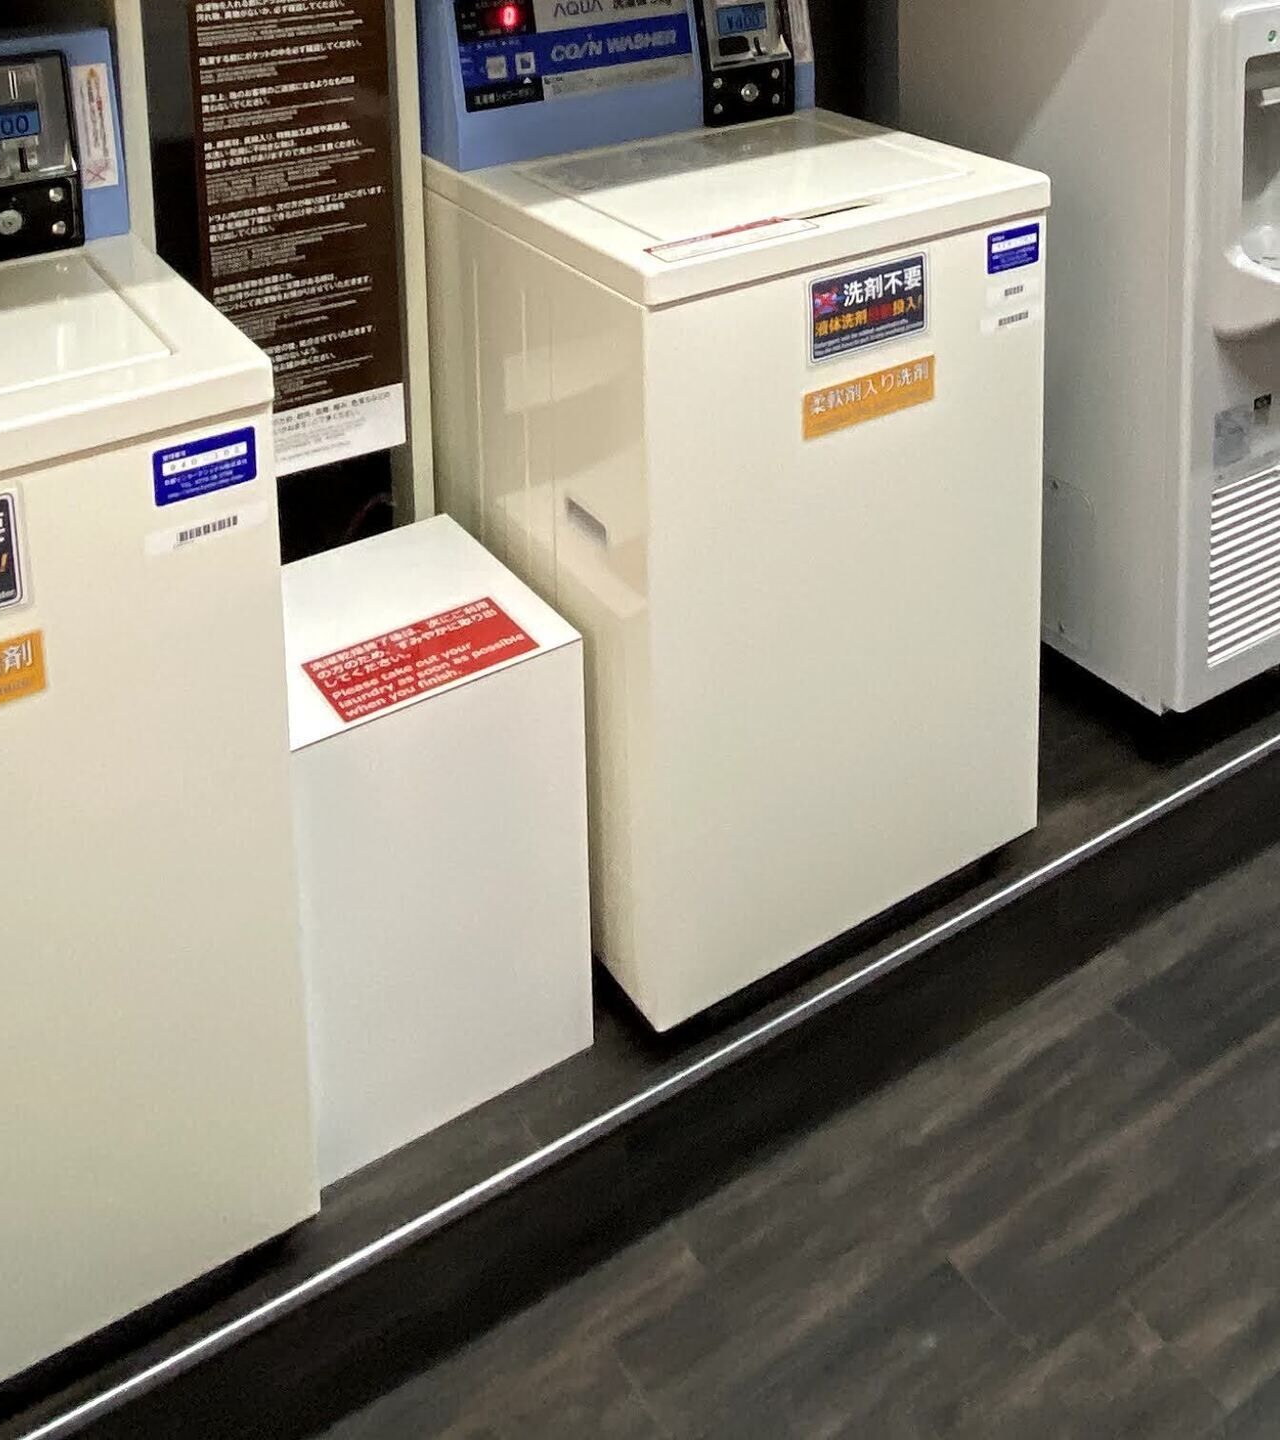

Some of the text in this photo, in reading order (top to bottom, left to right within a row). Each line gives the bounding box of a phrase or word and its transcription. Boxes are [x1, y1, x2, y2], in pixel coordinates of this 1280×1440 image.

[504, 5, 516, 27] 0
[550, 28, 678, 62] COIN WASHER
[843, 264, 922, 307] 洗剤不要
[810, 362, 929, 416] 柔軟剤入り洗剤
[331, 642, 472, 701] Please take out your
[338, 632, 525, 709] laundry as soon as possible
[345, 669, 463, 718] when you finish.
